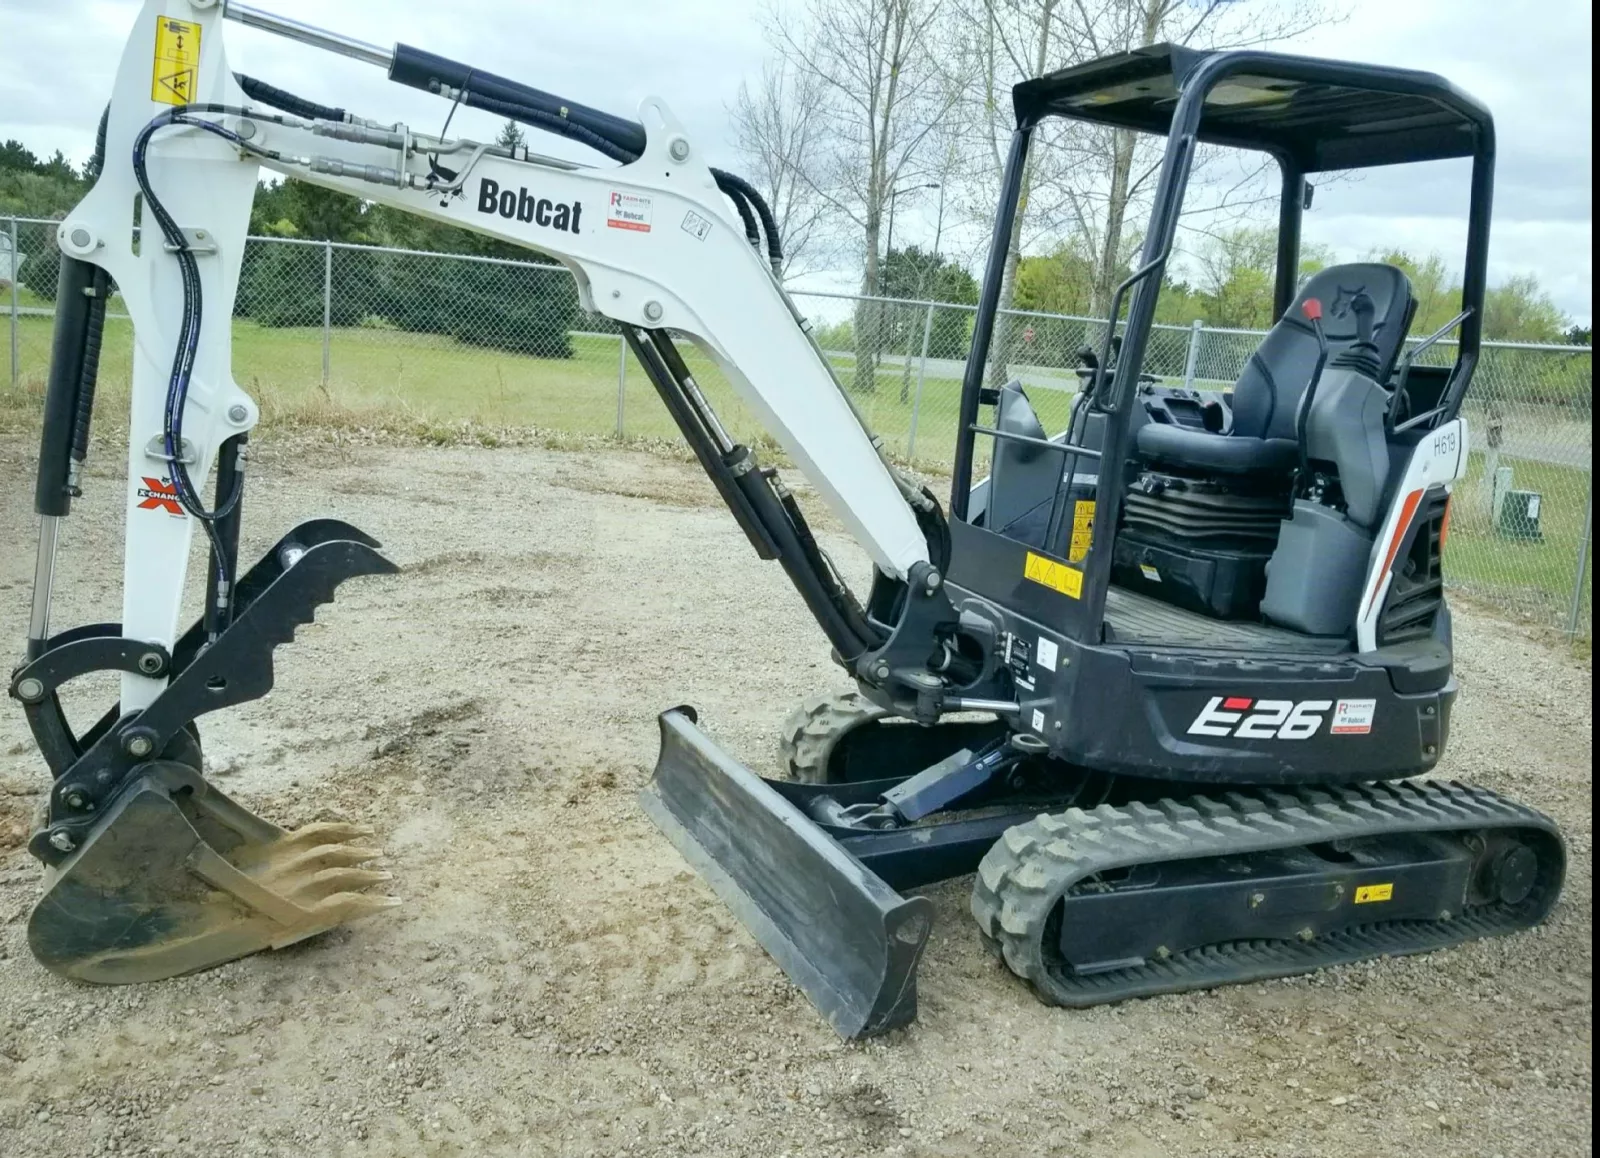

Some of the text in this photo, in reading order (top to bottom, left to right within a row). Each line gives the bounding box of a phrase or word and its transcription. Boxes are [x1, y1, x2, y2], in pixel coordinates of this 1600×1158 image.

[478, 177, 582, 235] Bobcat
[623, 211, 644, 221] Bobcat
[1434, 432, 1455, 457] H619
[138, 489, 181, 502] X-CHANG
[1186, 696, 1333, 740] E26
